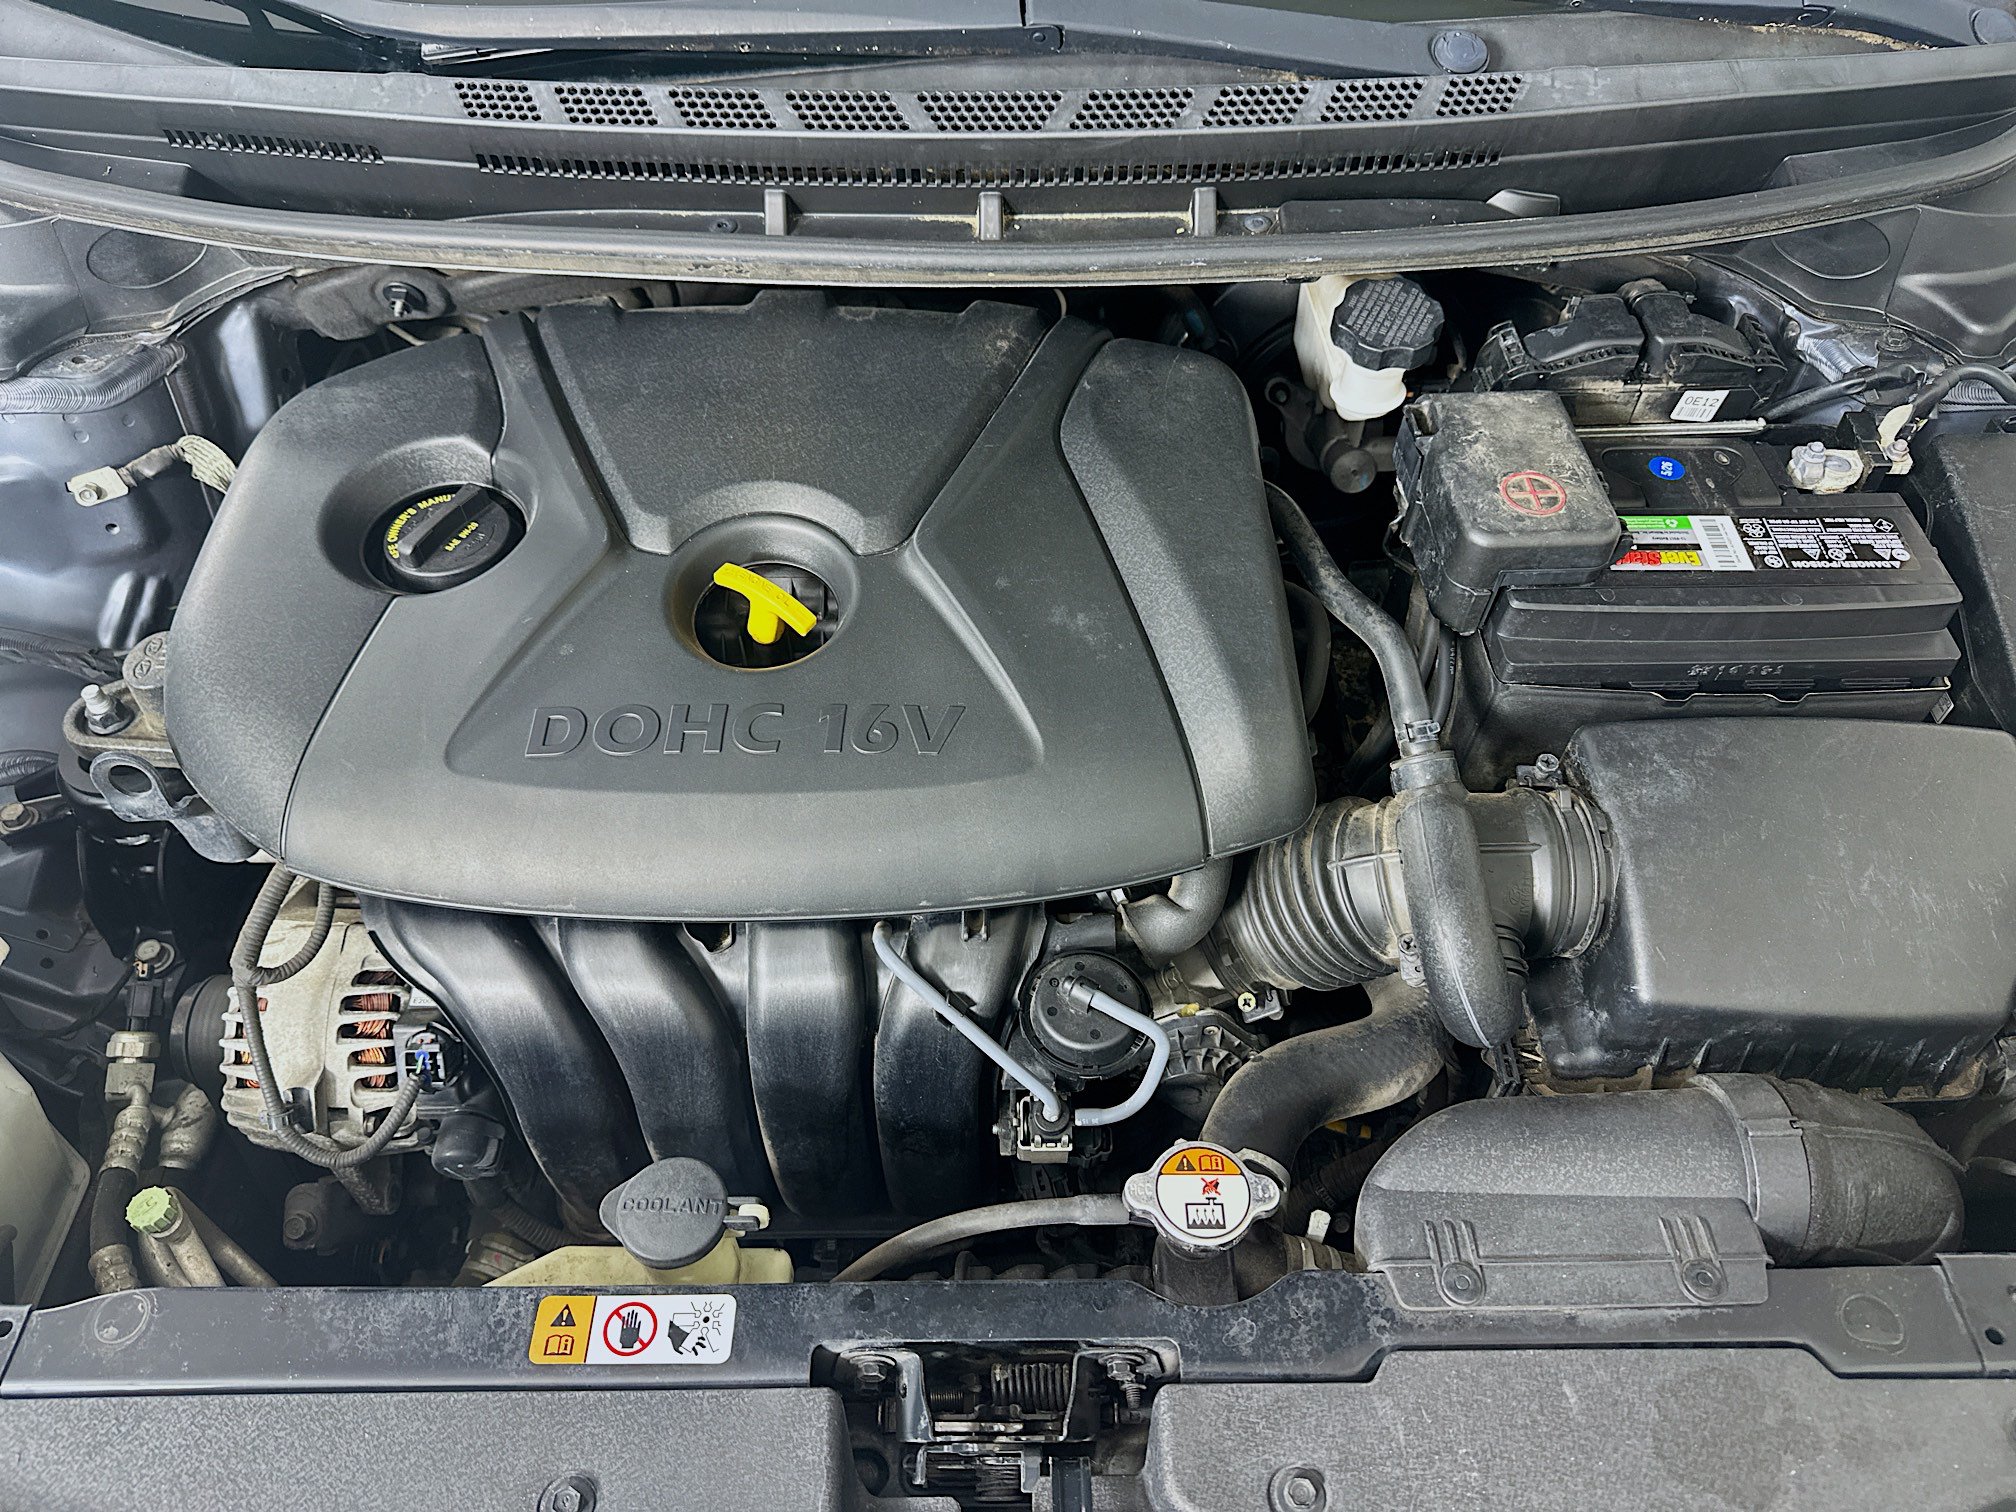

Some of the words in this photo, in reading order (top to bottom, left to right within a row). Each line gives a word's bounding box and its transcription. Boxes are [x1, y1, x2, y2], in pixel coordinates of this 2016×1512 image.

[387, 507, 417, 543] OWNER'S
[417, 493, 456, 510] MANU
[444, 538, 462, 552] SAE
[1616, 551, 1702, 566] EverStar
[1791, 561, 1892, 569] DANGER/POISON
[524, 703, 785, 758] DOHC
[818, 703, 967, 755] 16V
[619, 1196, 723, 1215] COOLANT
